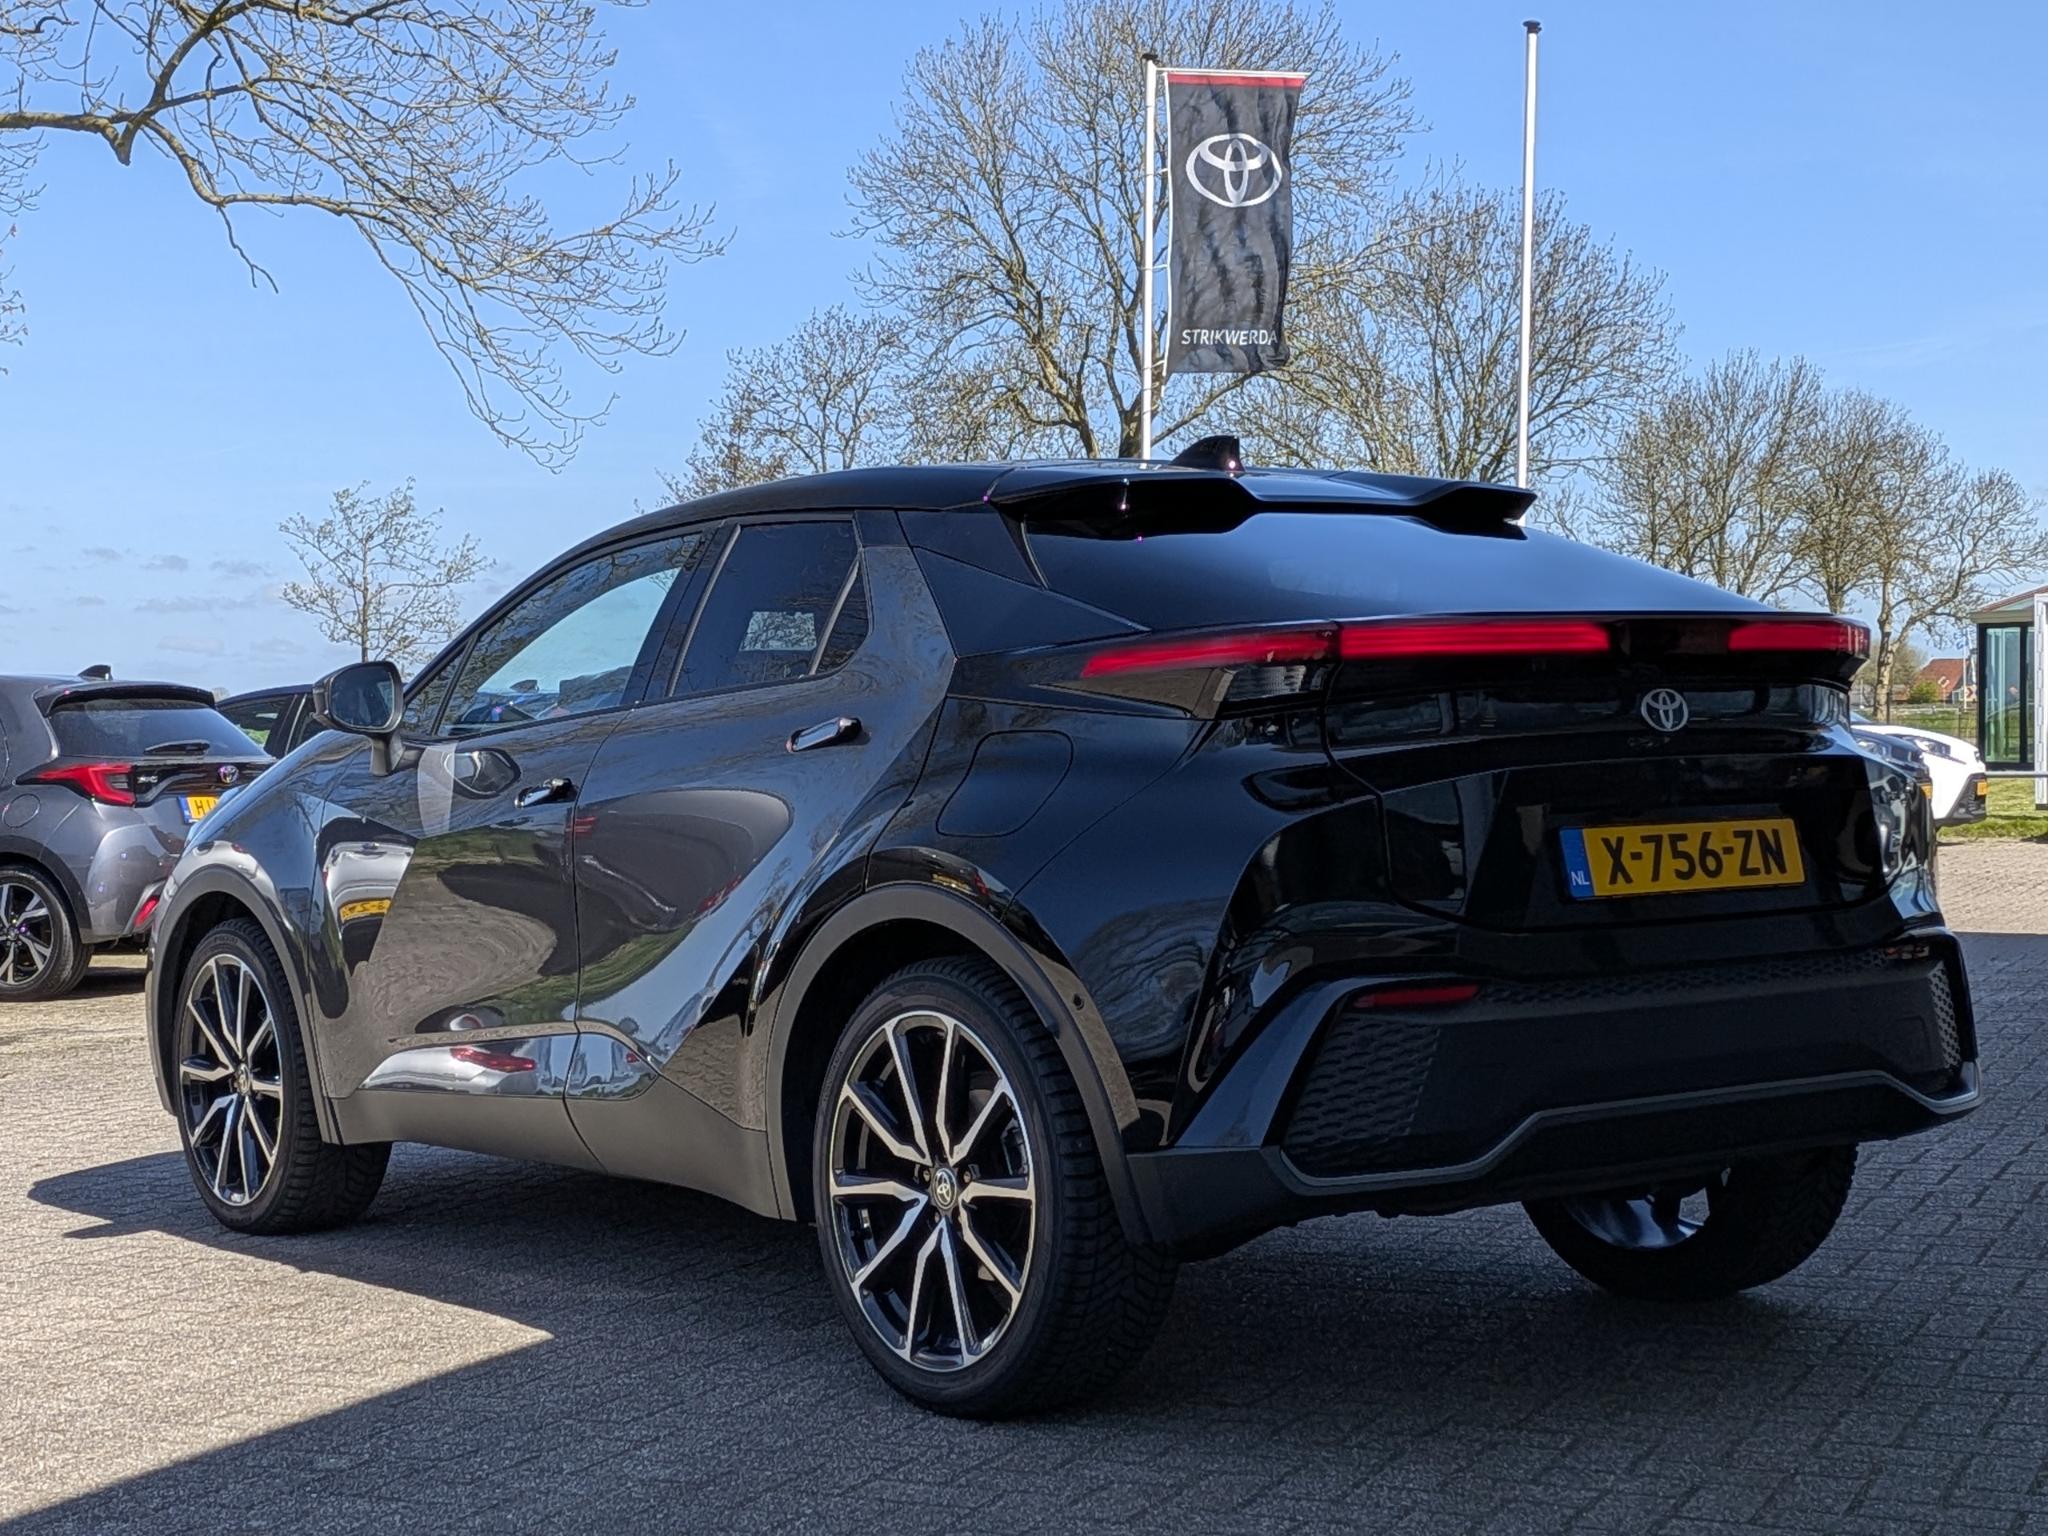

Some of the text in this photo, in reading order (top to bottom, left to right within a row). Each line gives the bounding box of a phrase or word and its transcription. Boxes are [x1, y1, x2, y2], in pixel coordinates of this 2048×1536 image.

[1181, 329, 1278, 346] STRIKWERDA
[1601, 828, 1788, 885] X-756-ZN
[1571, 871, 1590, 886] NL
